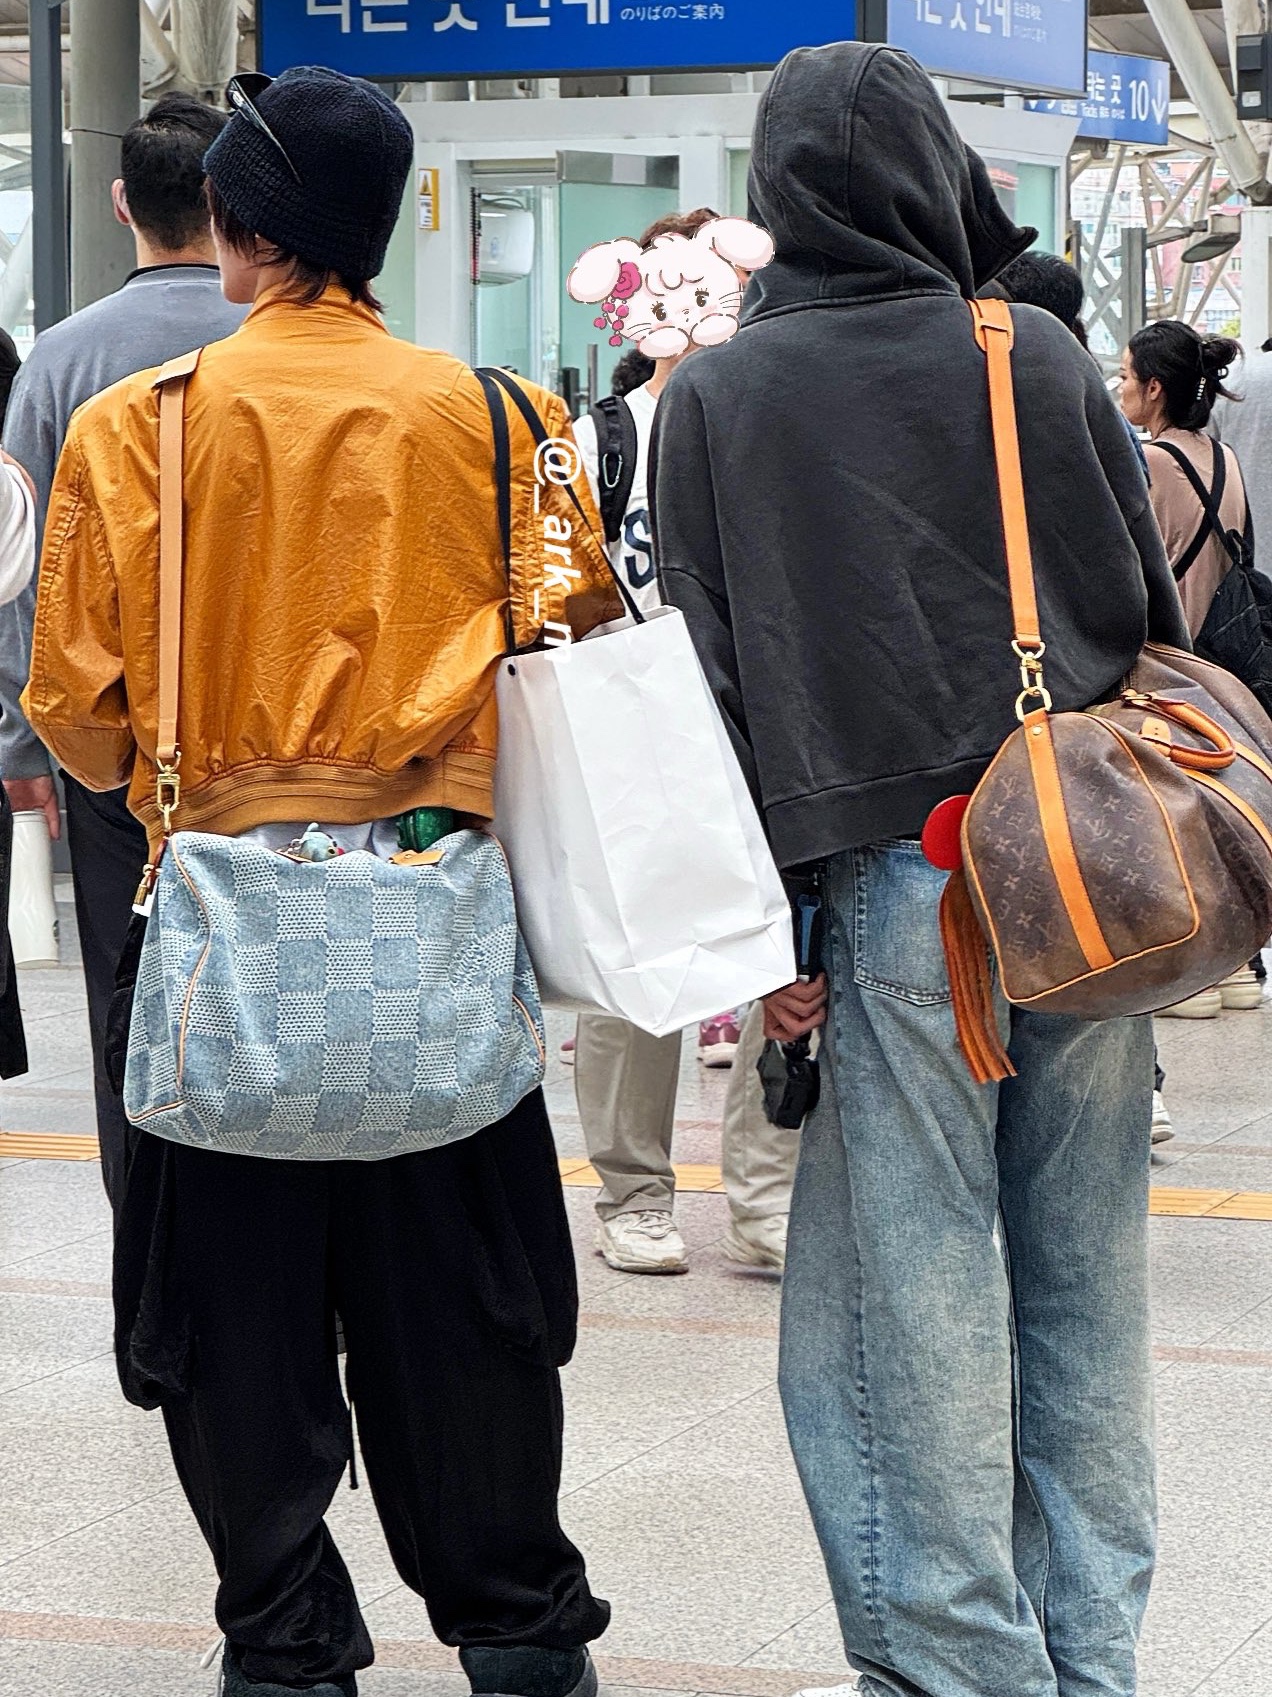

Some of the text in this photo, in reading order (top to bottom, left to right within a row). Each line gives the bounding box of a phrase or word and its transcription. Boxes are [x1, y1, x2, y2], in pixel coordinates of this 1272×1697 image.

[620, 3, 725, 21] のりばのご案内
[1129, 79, 1150, 121] 10
